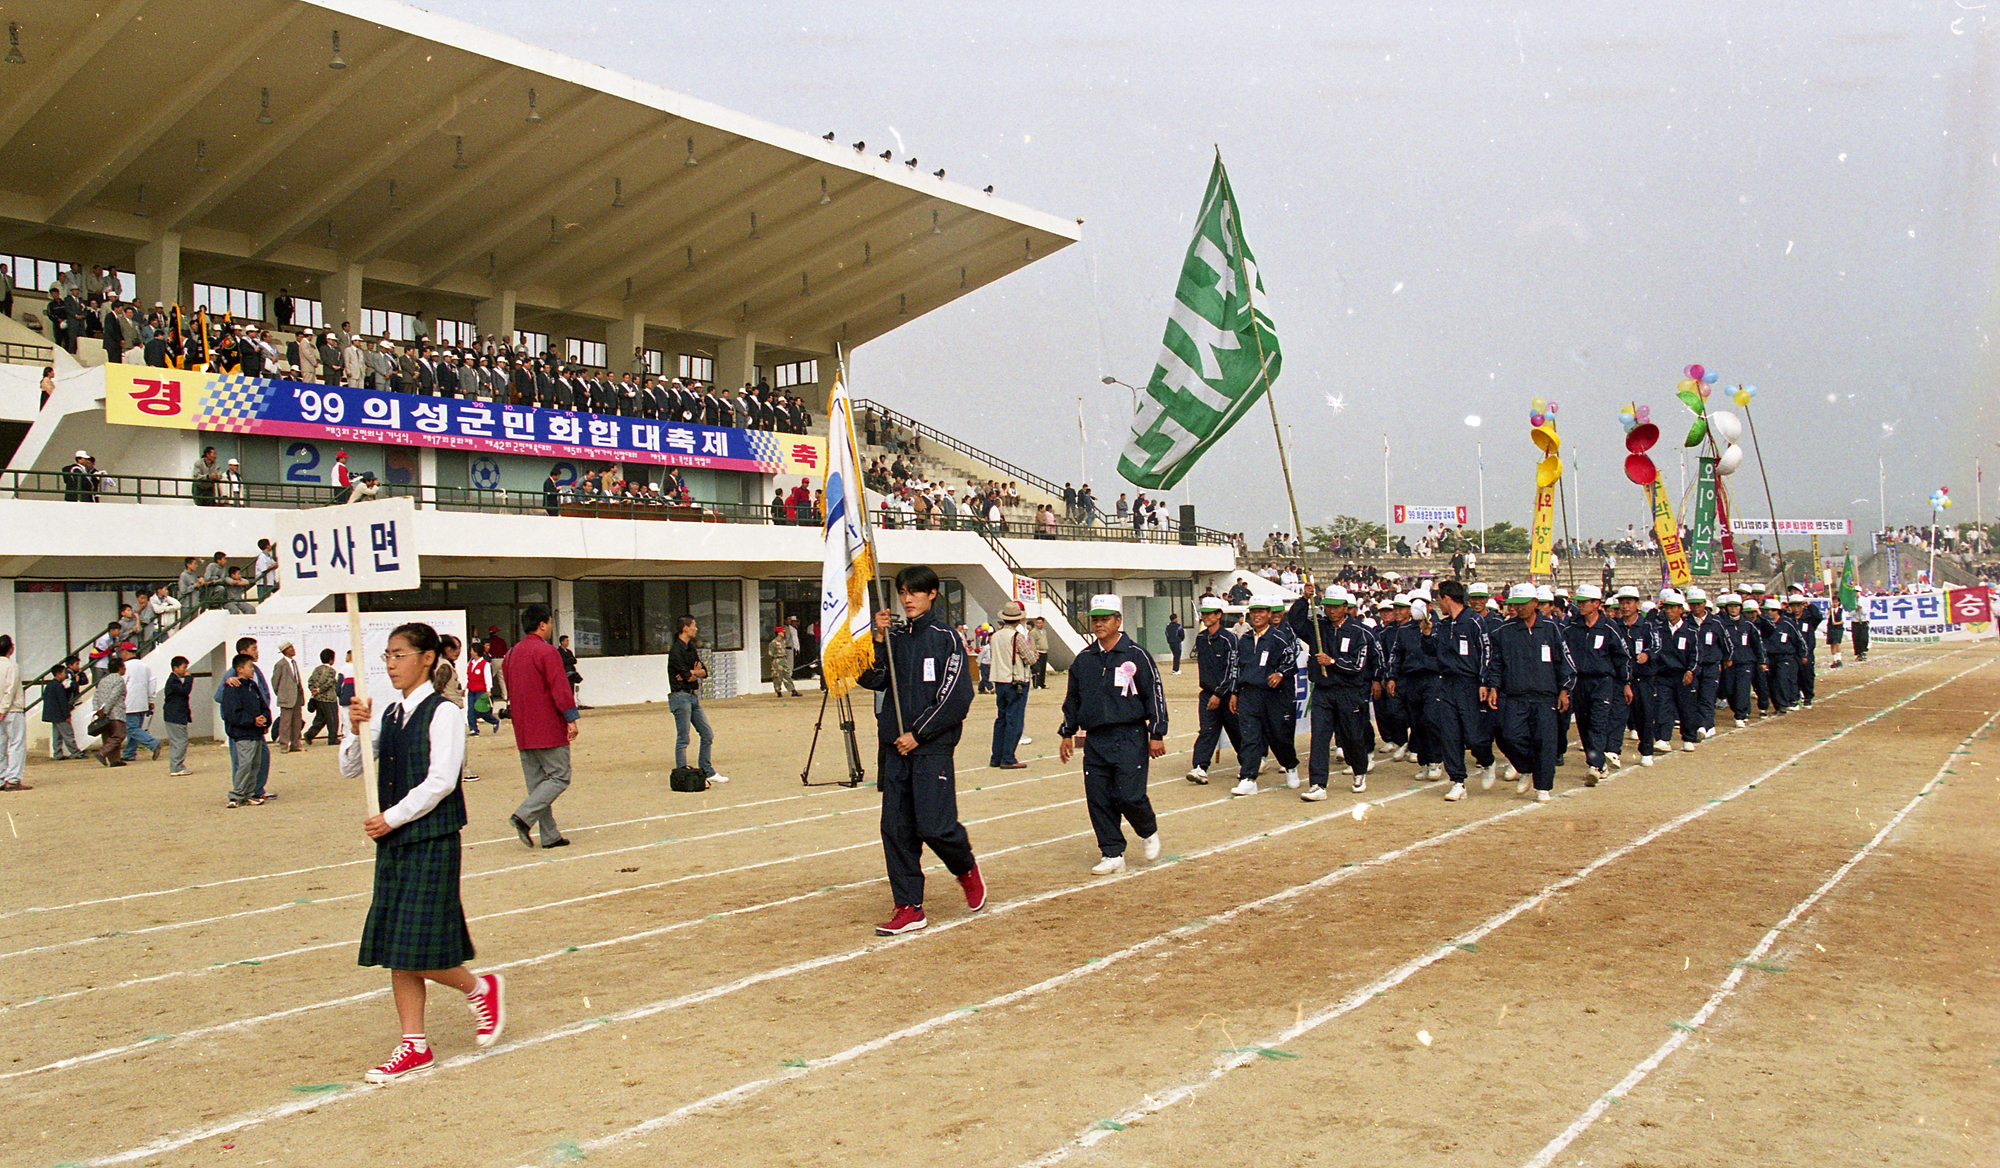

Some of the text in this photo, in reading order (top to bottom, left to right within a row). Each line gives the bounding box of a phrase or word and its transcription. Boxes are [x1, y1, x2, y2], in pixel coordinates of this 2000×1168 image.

[127, 378, 182, 416] 경
[293, 388, 345, 423] '99
[791, 444, 818, 469] 축
[1869, 596, 1939, 620] 선수단
[1954, 593, 1986, 616] 승
